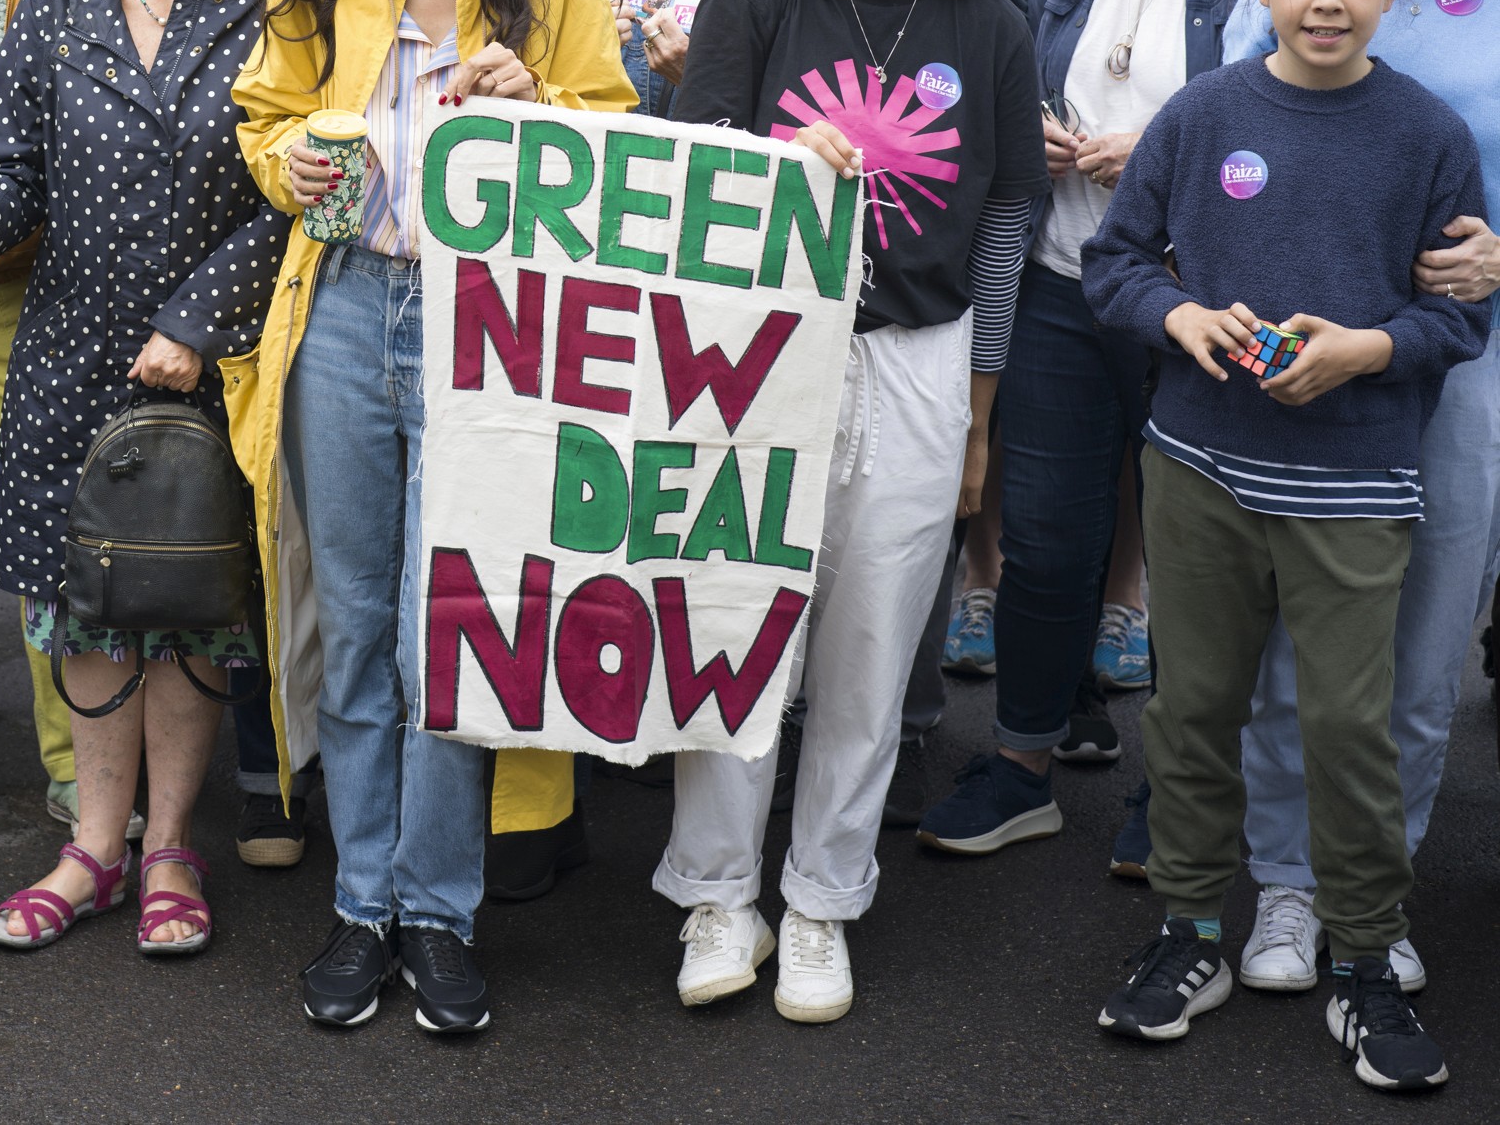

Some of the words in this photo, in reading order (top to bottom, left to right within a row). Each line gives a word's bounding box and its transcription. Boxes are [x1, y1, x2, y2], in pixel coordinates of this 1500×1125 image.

[920, 70, 957, 95] Faiza
[421, 114, 860, 301] GREEN
[1224, 163, 1263, 180] Faiza
[452, 256, 801, 437] NEW
[550, 421, 813, 572] DEAL
[424, 546, 809, 743] NOW
